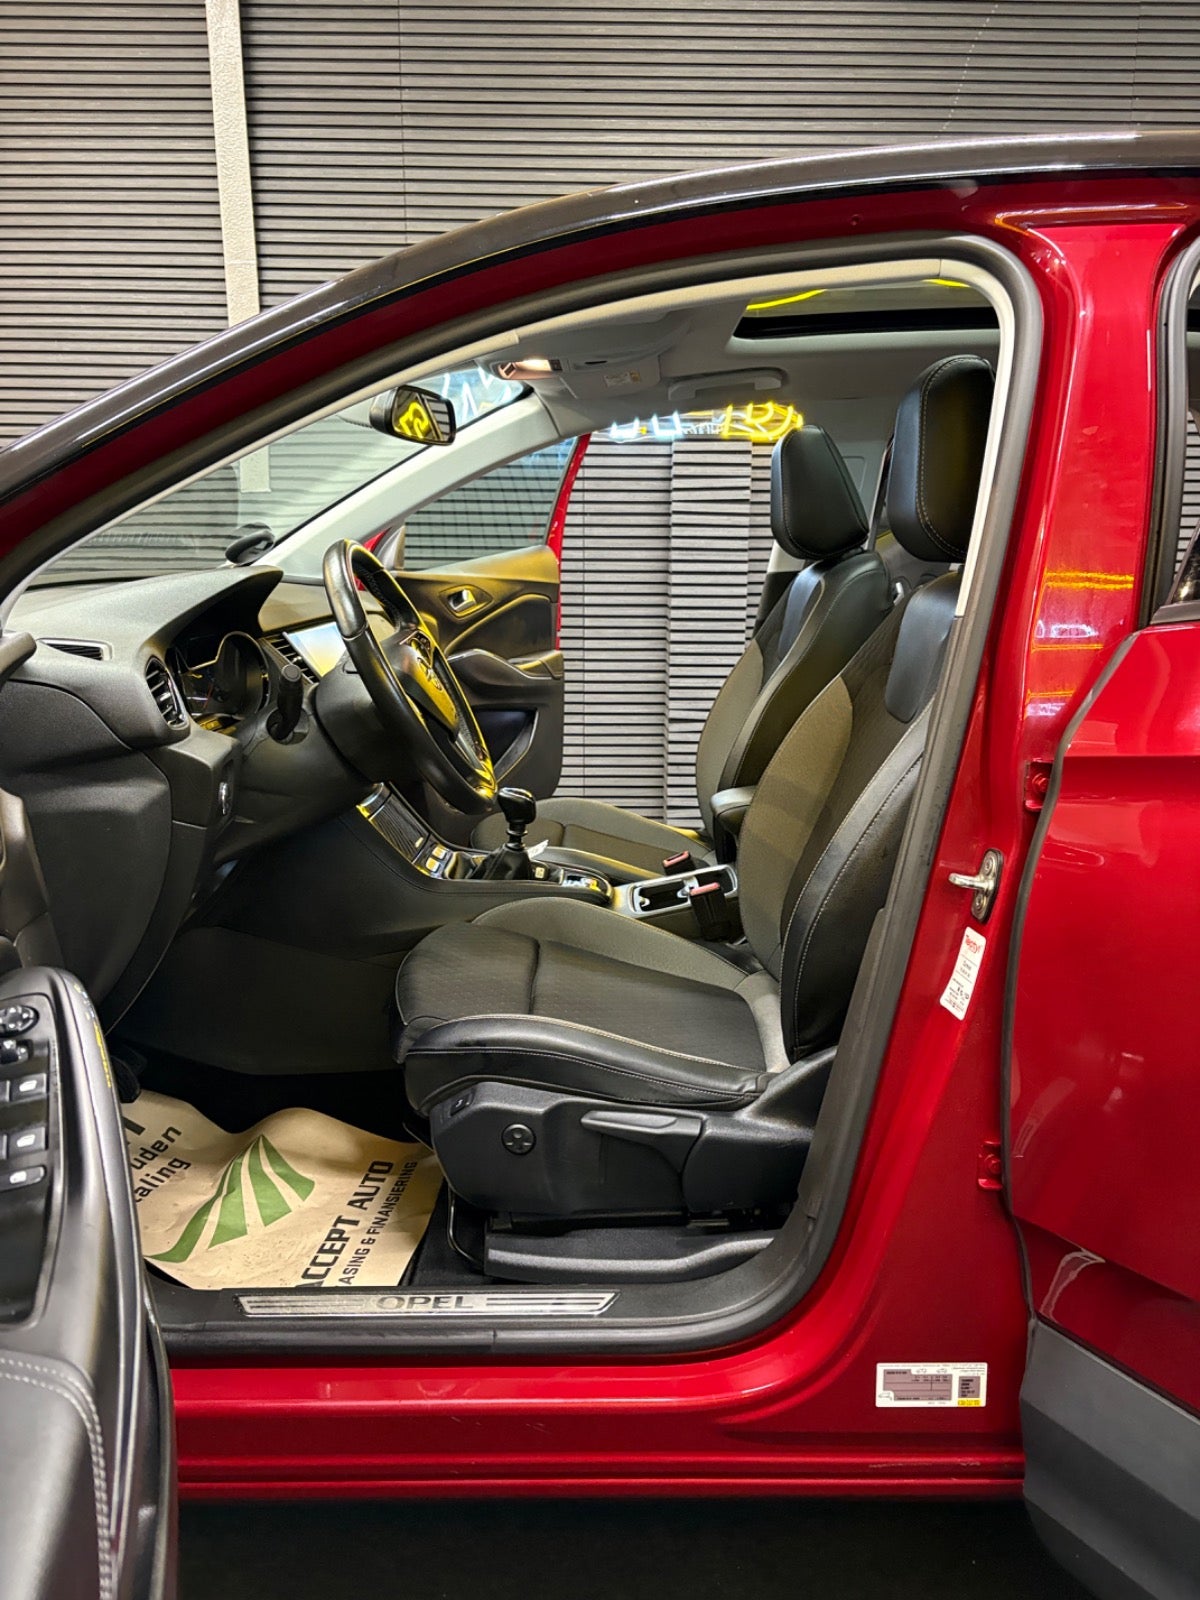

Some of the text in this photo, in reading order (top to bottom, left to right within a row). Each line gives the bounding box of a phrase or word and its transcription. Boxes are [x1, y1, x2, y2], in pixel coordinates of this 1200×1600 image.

[346, 1160, 395, 1211] AUTO
[337, 1161, 418, 1286] ASING & FINANSIERING
[376, 1295, 474, 1310] OPEL
